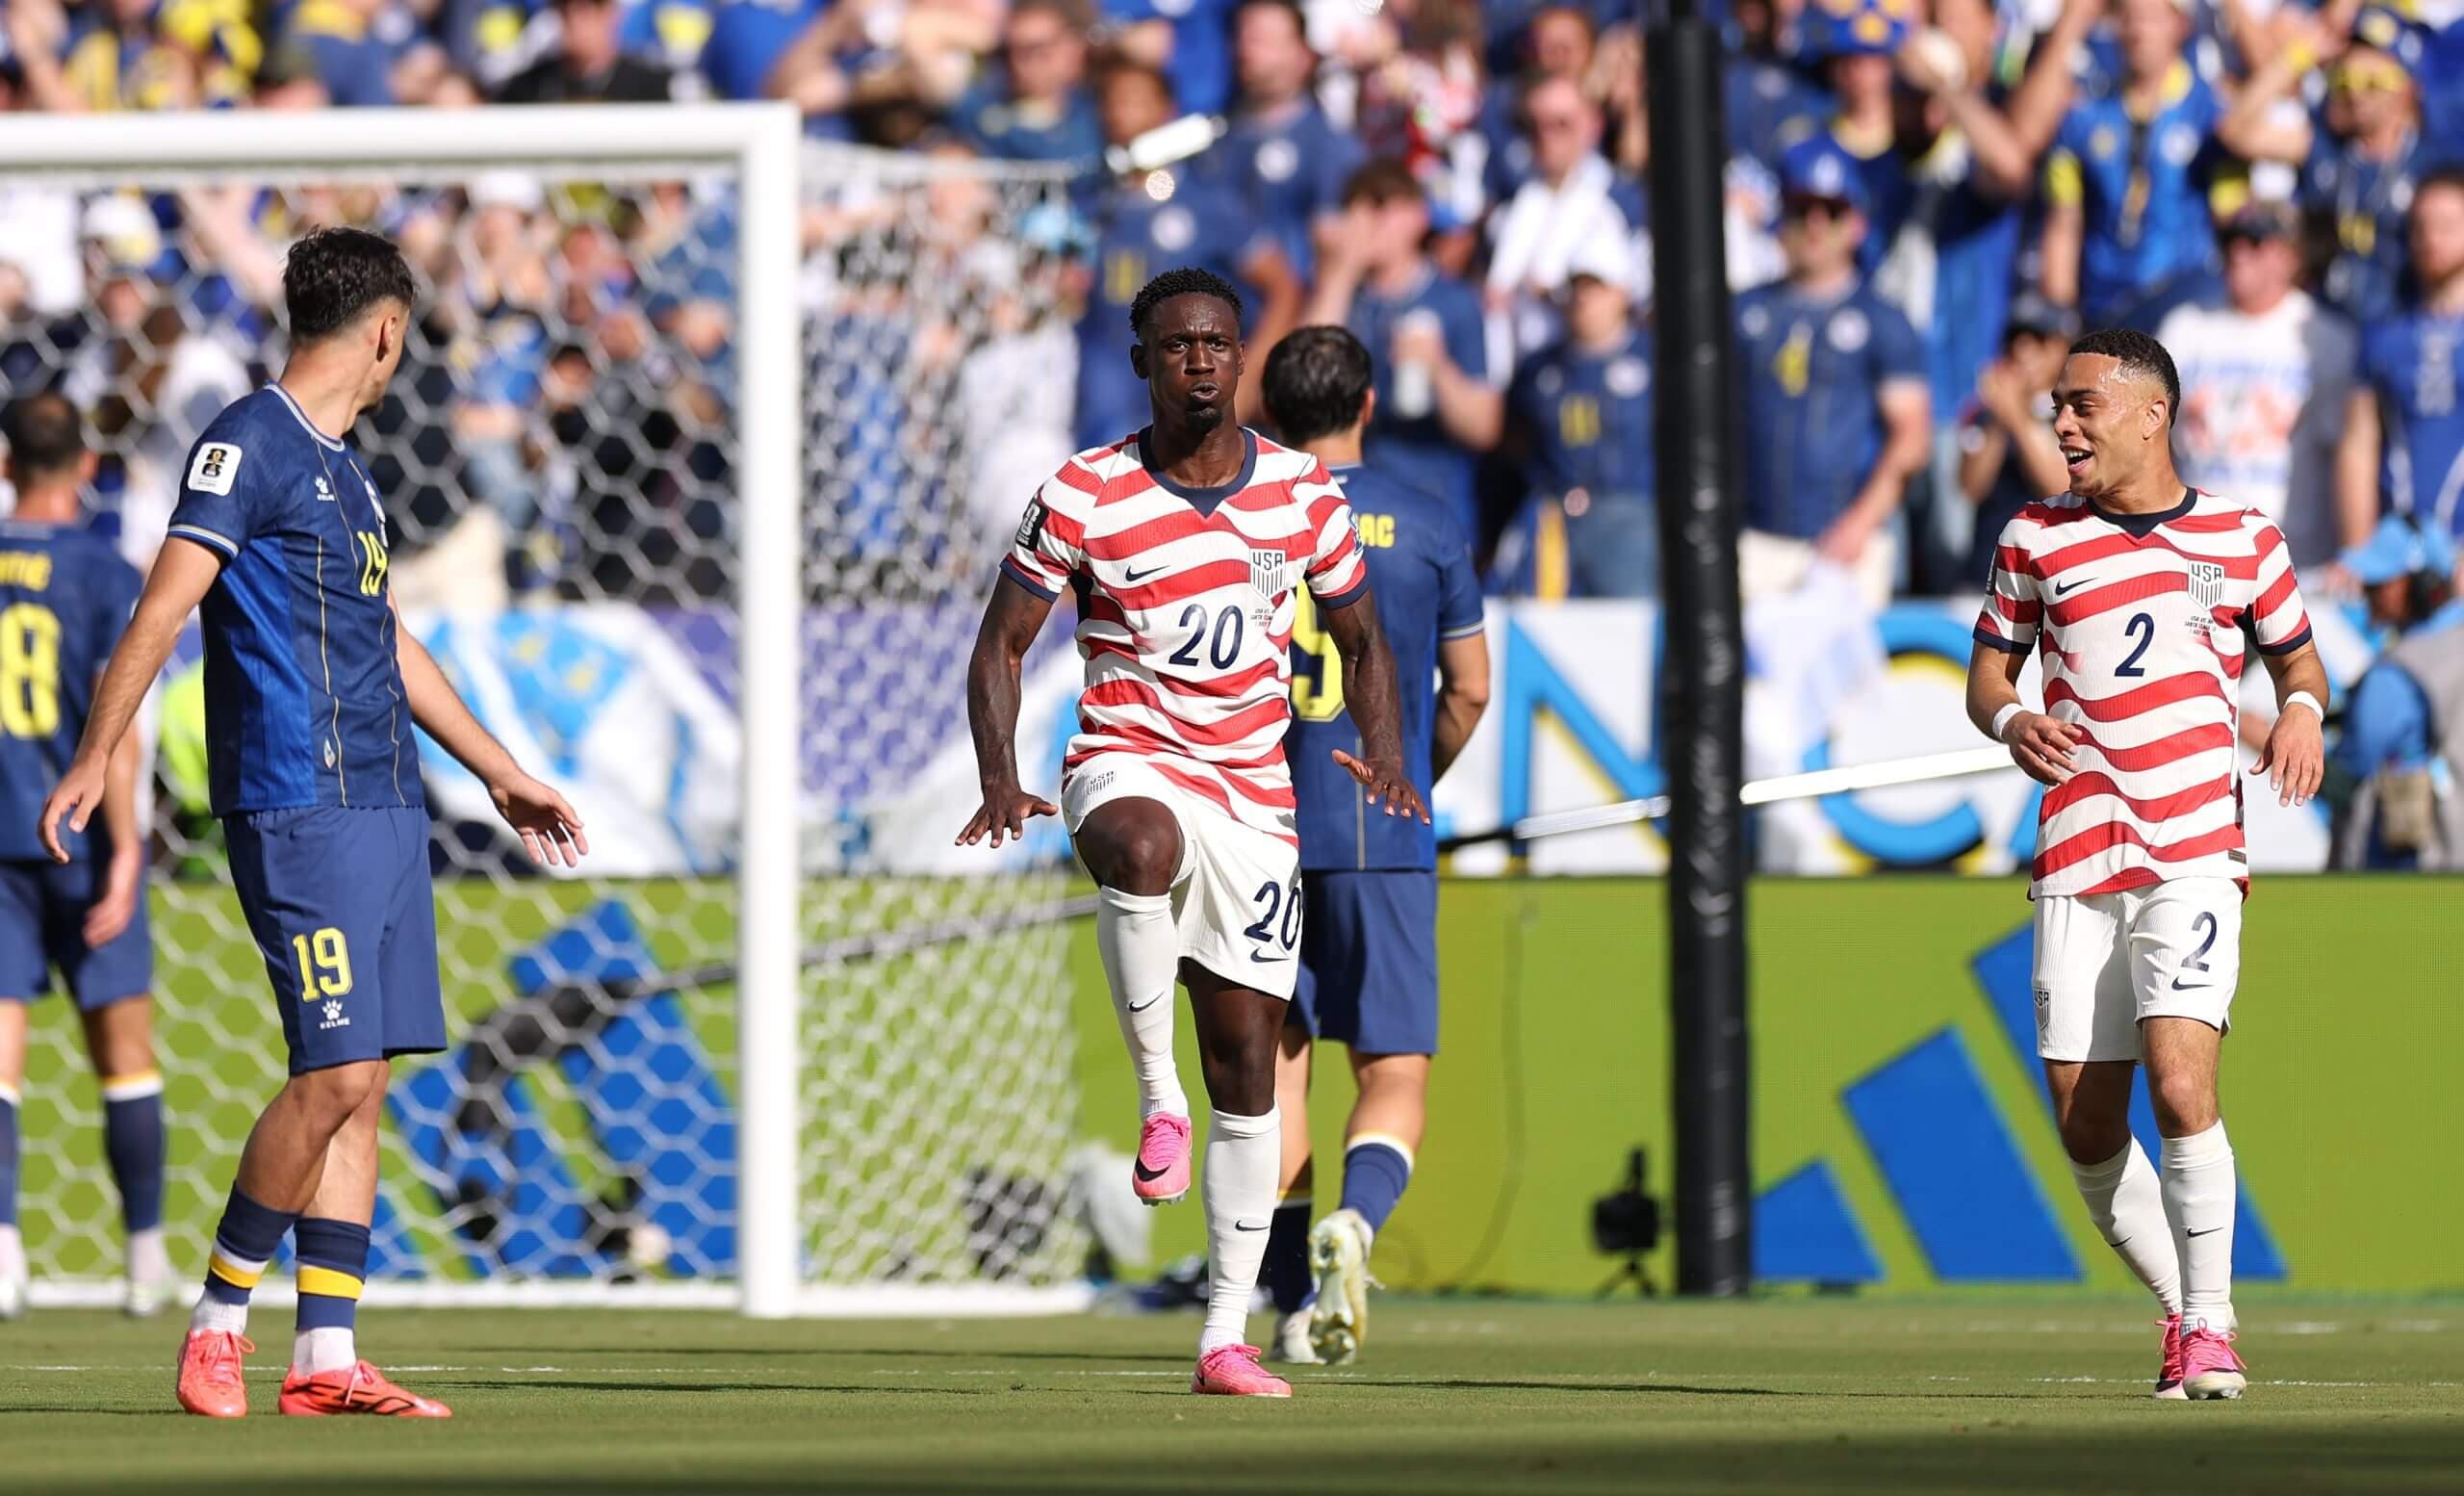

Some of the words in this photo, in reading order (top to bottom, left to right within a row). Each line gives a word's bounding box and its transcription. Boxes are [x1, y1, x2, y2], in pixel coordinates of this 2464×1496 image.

[357, 530, 388, 597] 19
[1252, 551, 1284, 571] USA
[2191, 563, 2222, 582] USA
[0, 601, 62, 740] 8
[1168, 603, 1244, 671] 20
[2114, 612, 2155, 678] 2
[1243, 880, 1303, 952] 20
[2180, 911, 2218, 972] 2
[292, 927, 354, 1002] 19
